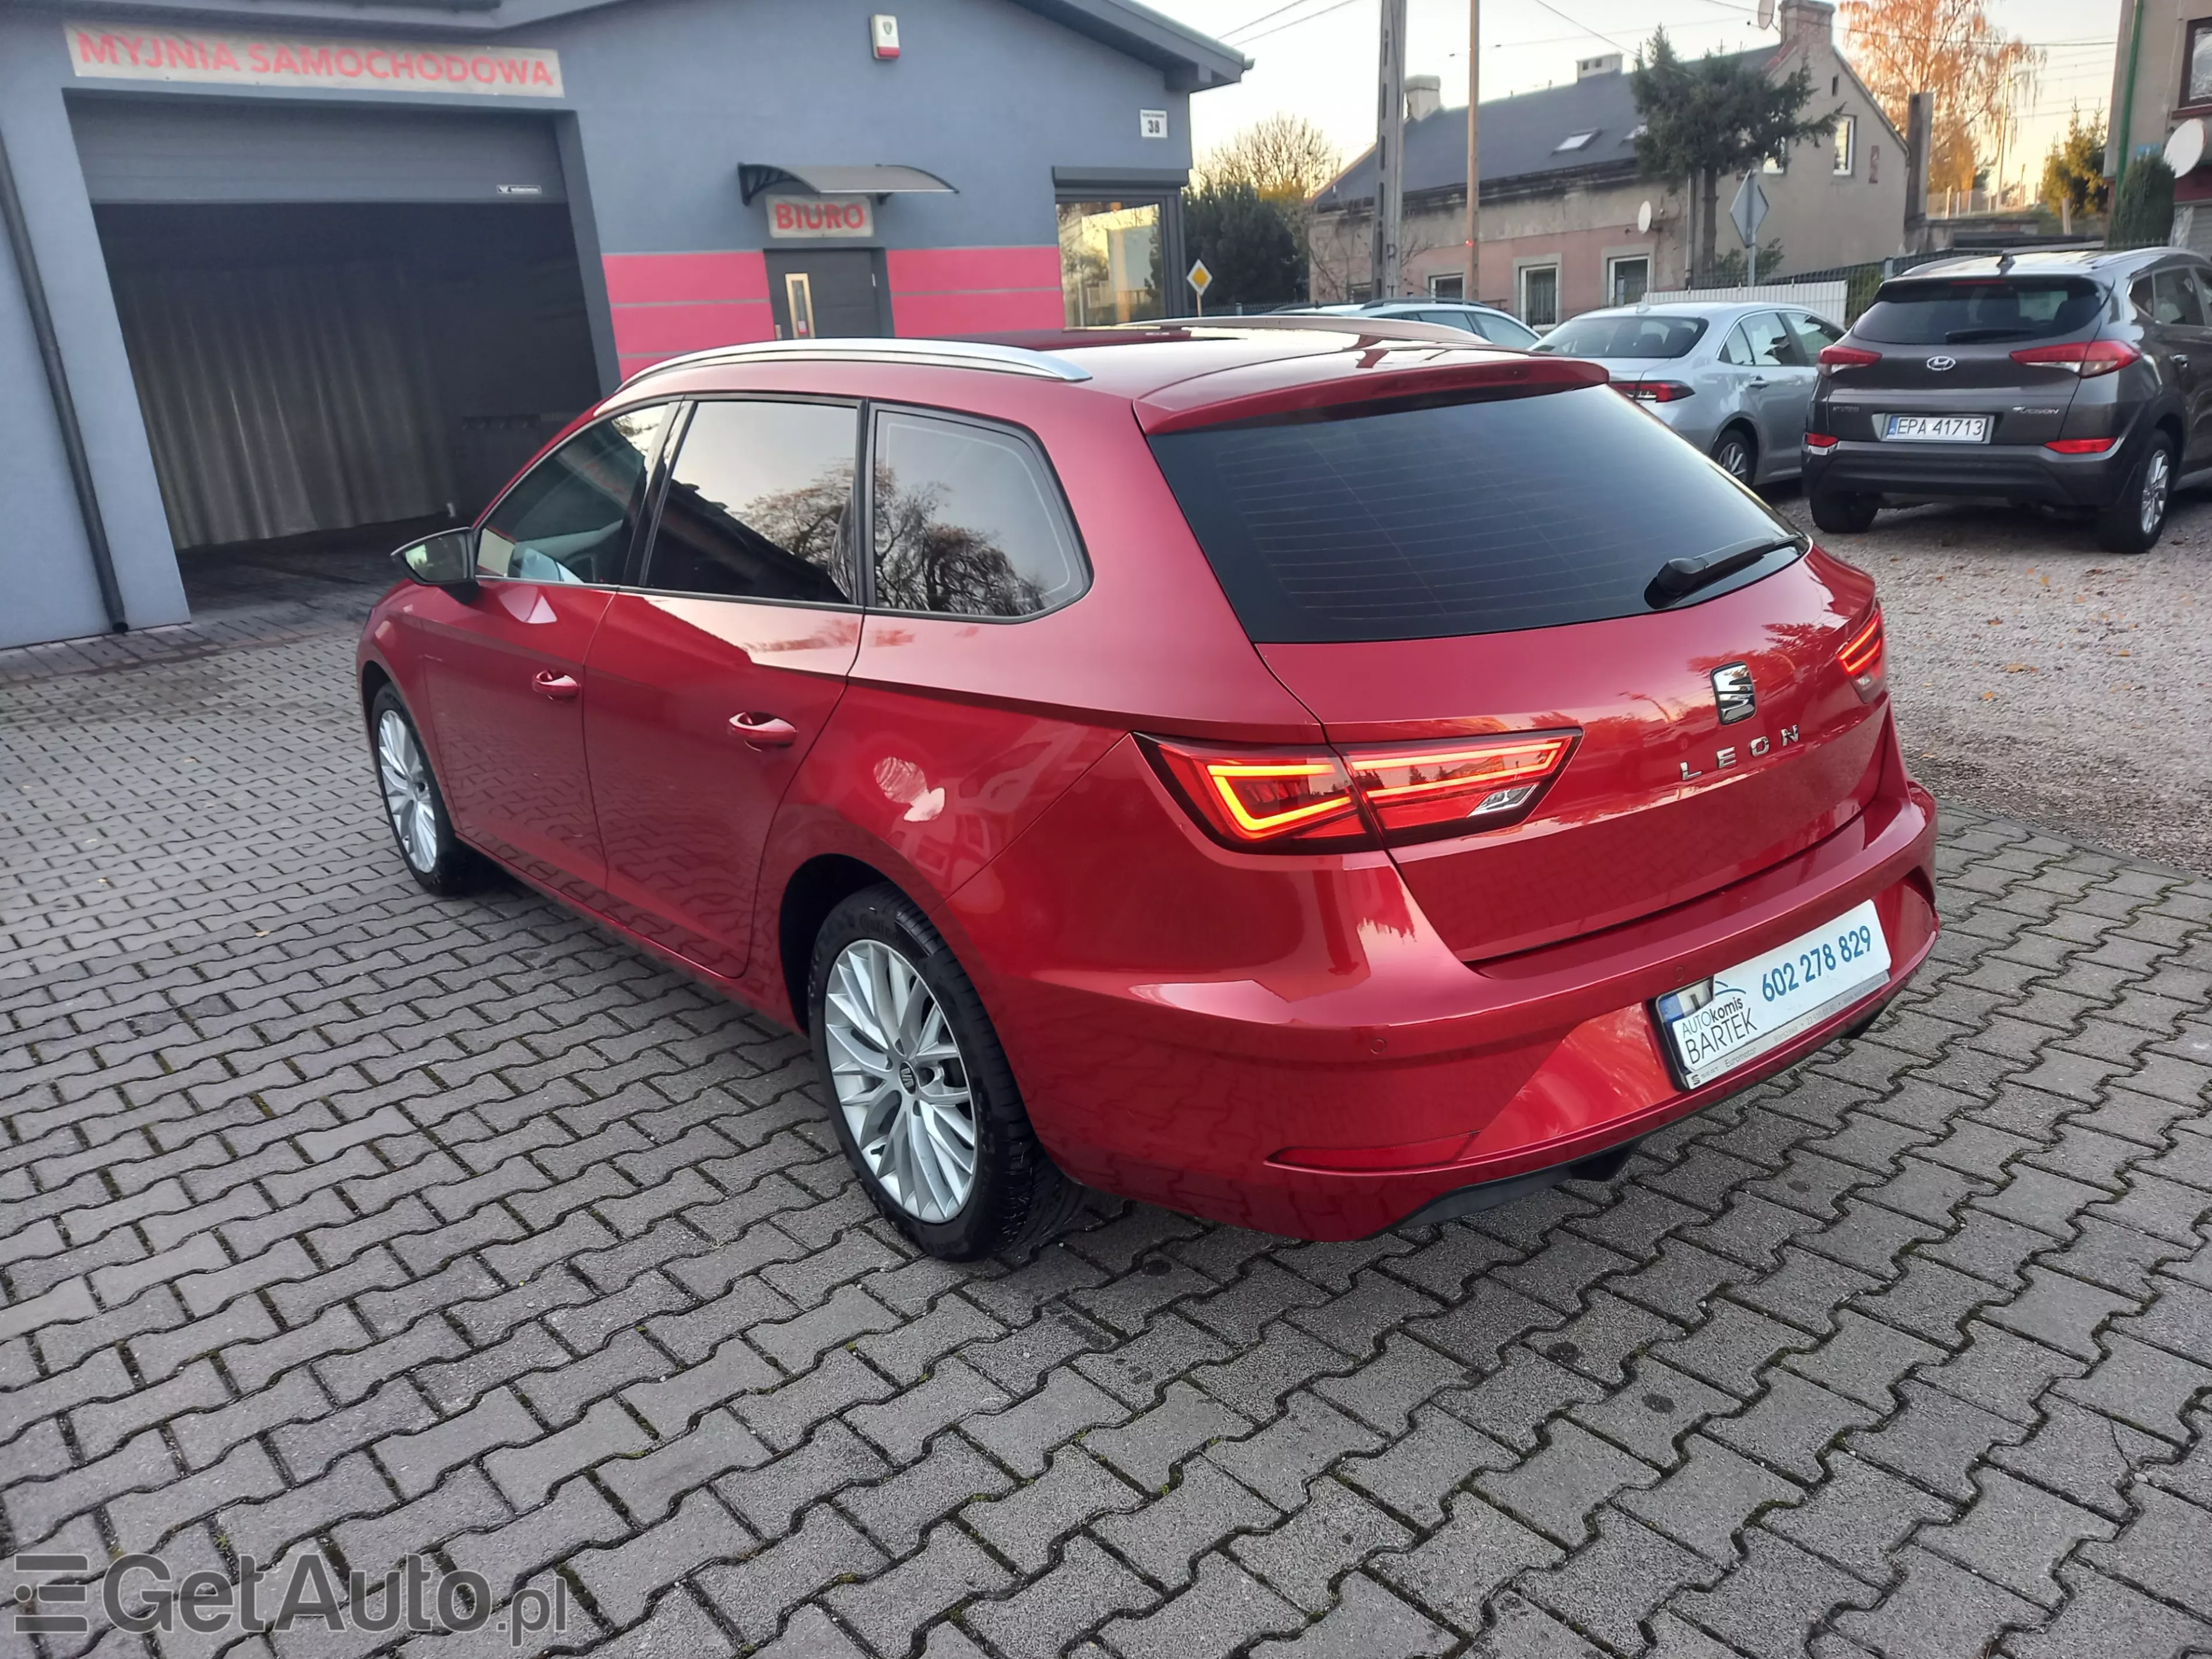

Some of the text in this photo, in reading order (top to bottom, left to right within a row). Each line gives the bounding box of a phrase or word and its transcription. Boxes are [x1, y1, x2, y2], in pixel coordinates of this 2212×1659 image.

[76, 32, 554, 87] MYJNIA SAMOCHODOWA
[1148, 119, 1160, 133] 38
[775, 202, 865, 229] BIURO
[1897, 419, 1926, 434] EPA
[1932, 419, 1983, 435] 41713
[1679, 725, 1799, 781] LEON
[1762, 962, 1799, 1001] 602
[1800, 943, 1836, 982] 278
[1838, 926, 1870, 962] 829
[1682, 997, 1743, 1038] AUTOkomis
[1685, 1007, 1757, 1064] BARTEK
[1725, 1047, 1757, 1067] Euromotor
